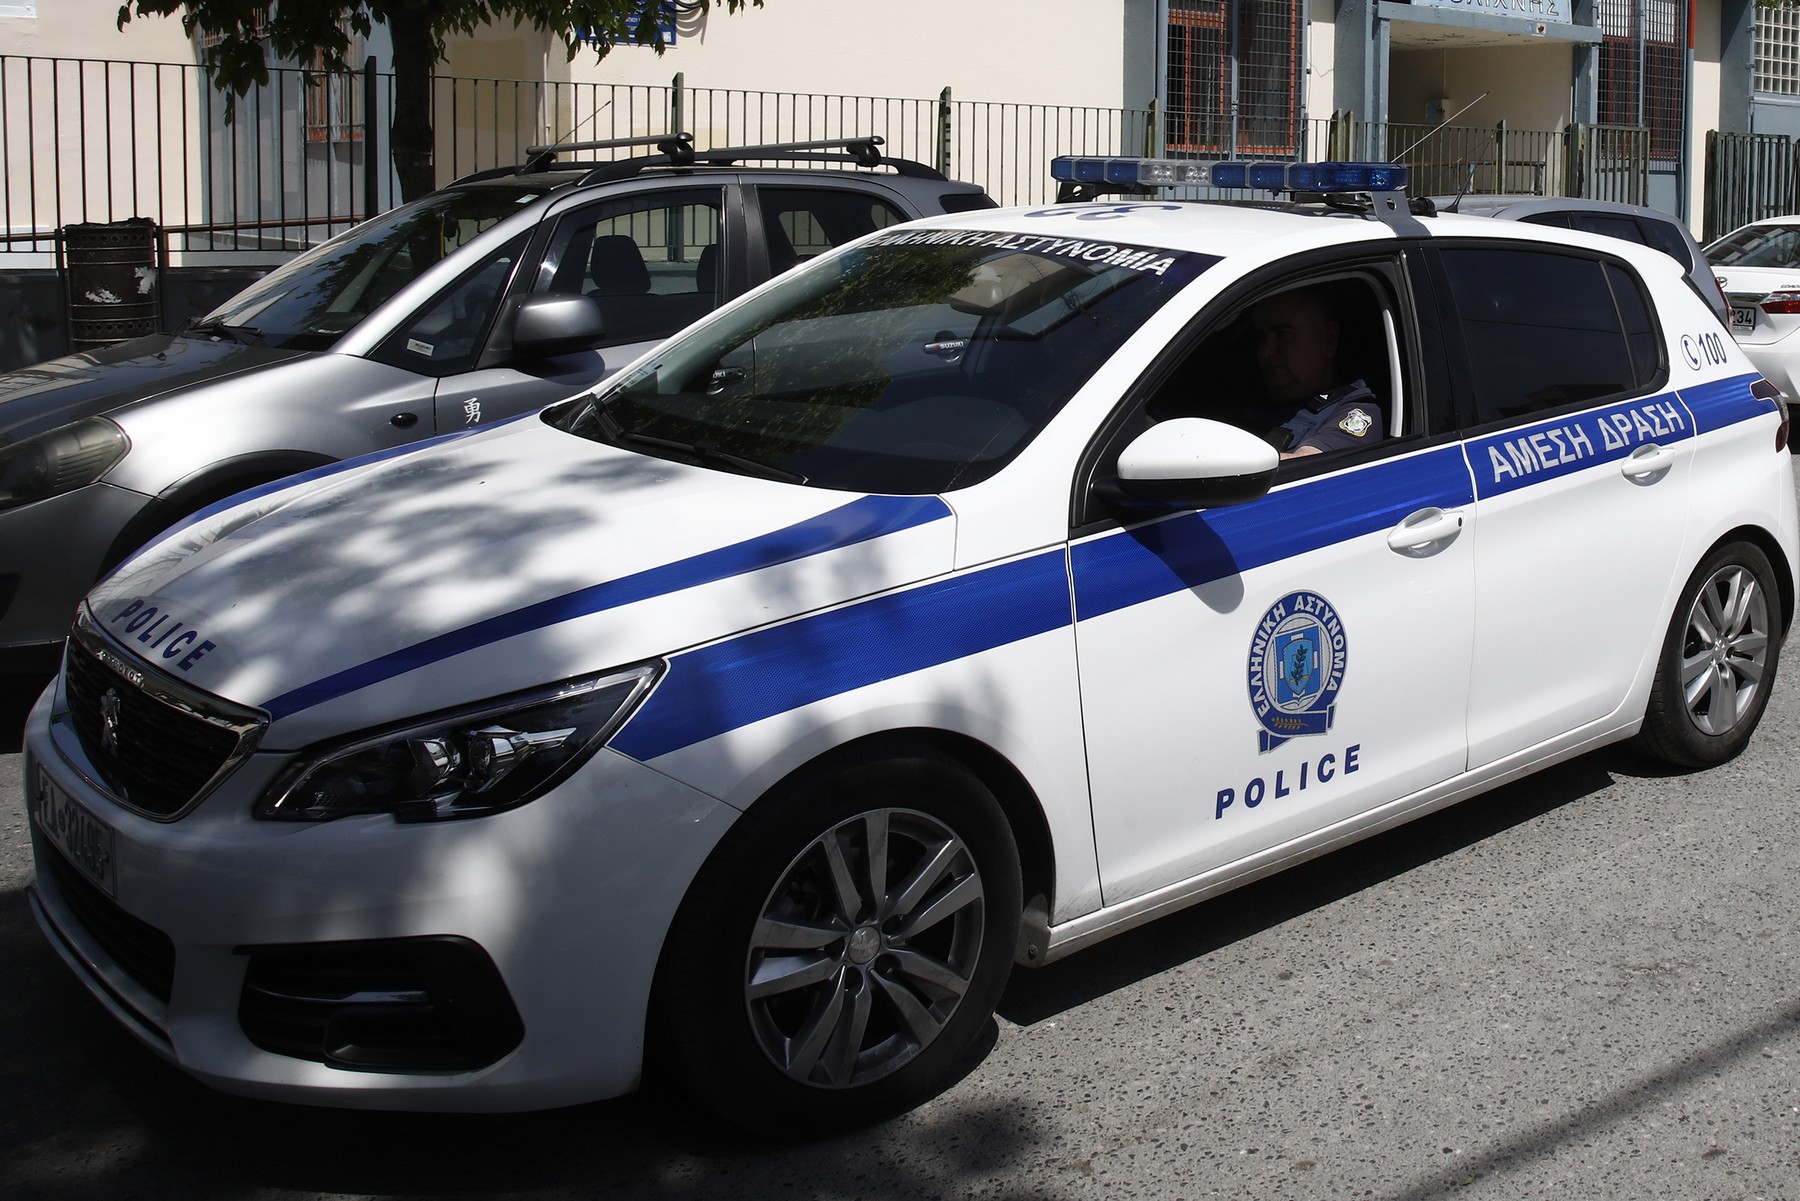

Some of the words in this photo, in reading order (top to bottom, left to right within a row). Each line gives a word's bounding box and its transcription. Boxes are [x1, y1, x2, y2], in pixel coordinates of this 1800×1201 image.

[980, 234, 1176, 277] ΑΣΤΥΝΟΜΙΑ
[940, 341, 964, 349] SUZUKI
[1698, 332, 1727, 366] 100
[463, 397, 481, 424] 勇
[1487, 423, 1595, 484] ΑΜΕΣΗ
[1597, 401, 1686, 452] ΔΡΑΣΗ
[111, 599, 217, 672] POLICE
[1250, 602, 1287, 718] ΕΛΛΗΝΙΚΗ
[1293, 595, 1345, 691] ΑΣΤΥΝΟΜΙΑ
[1215, 743, 1361, 820] POLICE
